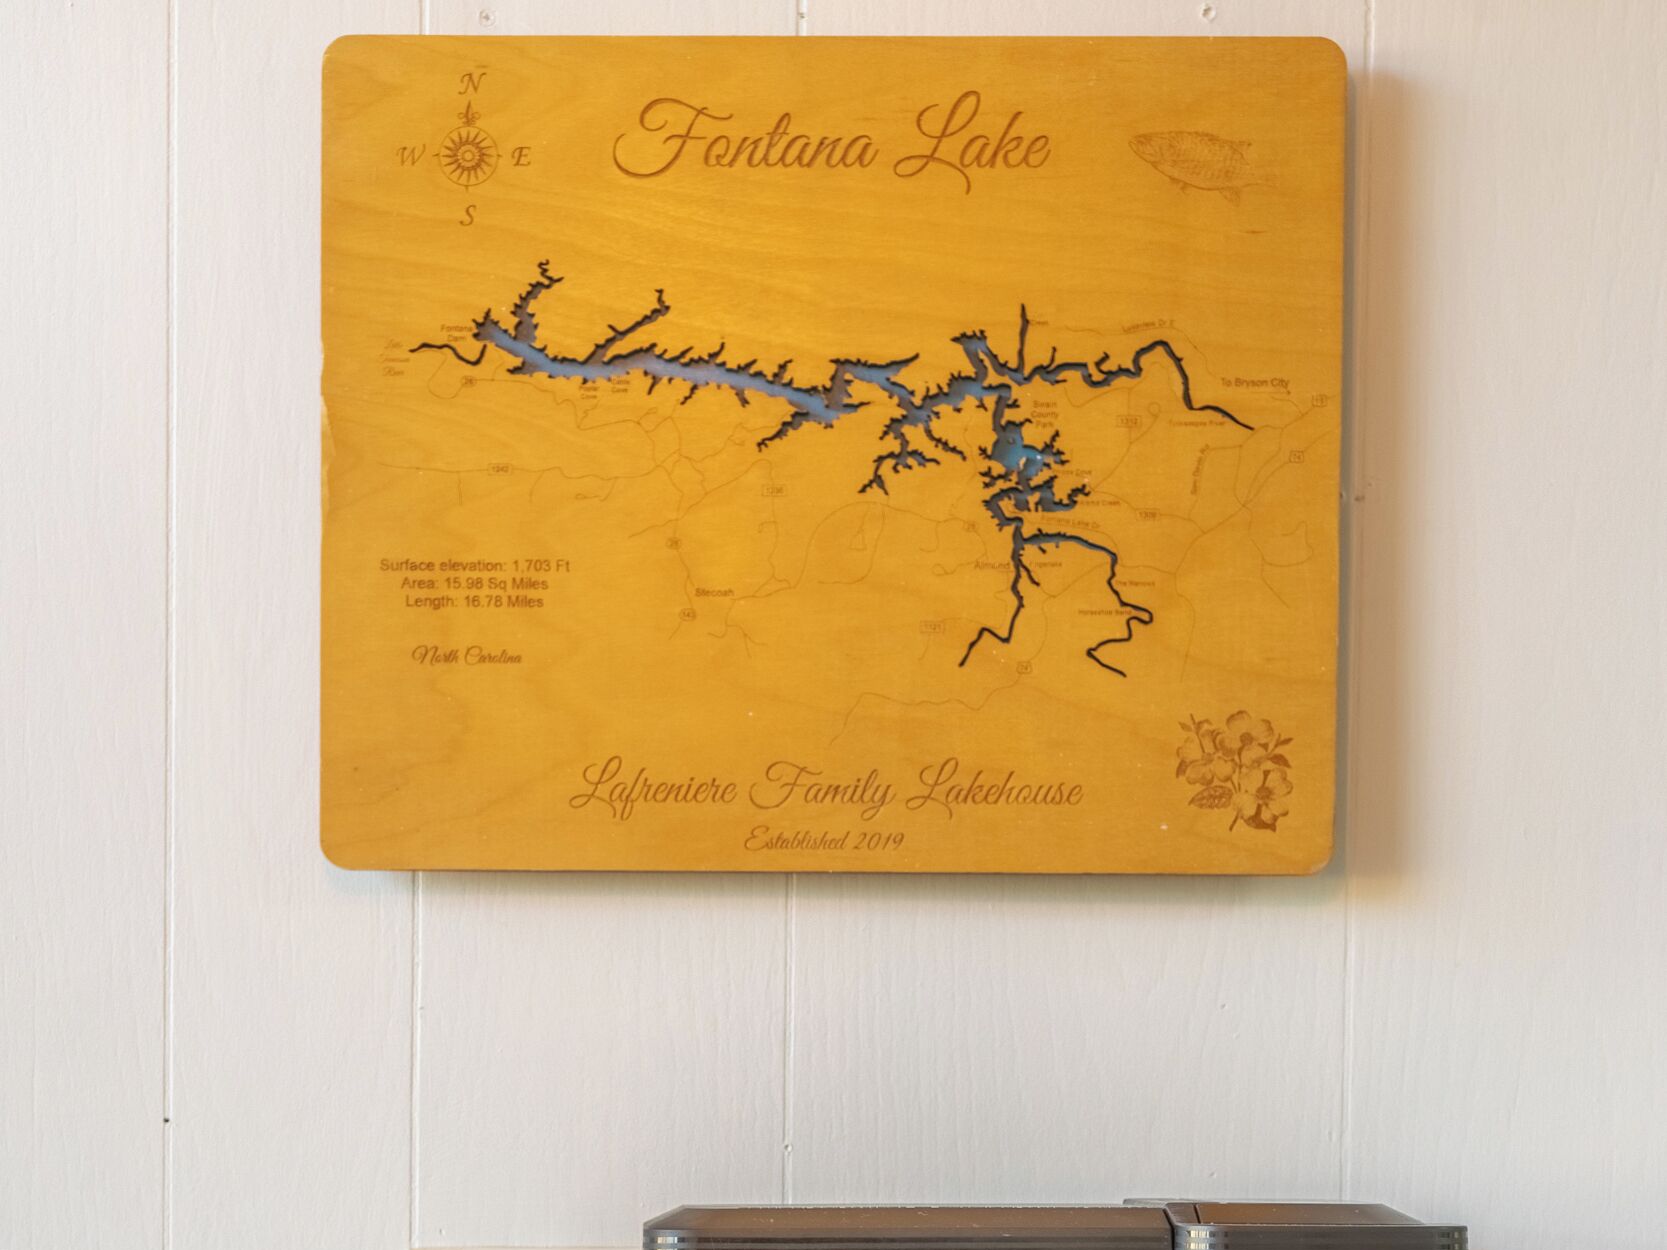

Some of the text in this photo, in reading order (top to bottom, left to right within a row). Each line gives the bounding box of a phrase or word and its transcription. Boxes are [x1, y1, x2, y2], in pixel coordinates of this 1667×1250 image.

[458, 72, 487, 95] N
[612, 90, 1052, 195] Fontana Lake
[396, 143, 426, 167] W
[511, 146, 532, 167] E
[459, 204, 477, 226] S
[1220, 377, 1290, 389] To Bryson City
[379, 558, 571, 574] Surface elevation: 1,703 Ft
[401, 577, 549, 592] Area: 15.98 Sq Miles
[694, 588, 735, 597] Stecoah
[405, 595, 544, 610] Length: 16.78 Miles
[411, 645, 523, 666] North Carolina
[568, 755, 1084, 821] Lafreniere Family Lakehouse
[744, 825, 905, 851] Established 2019
